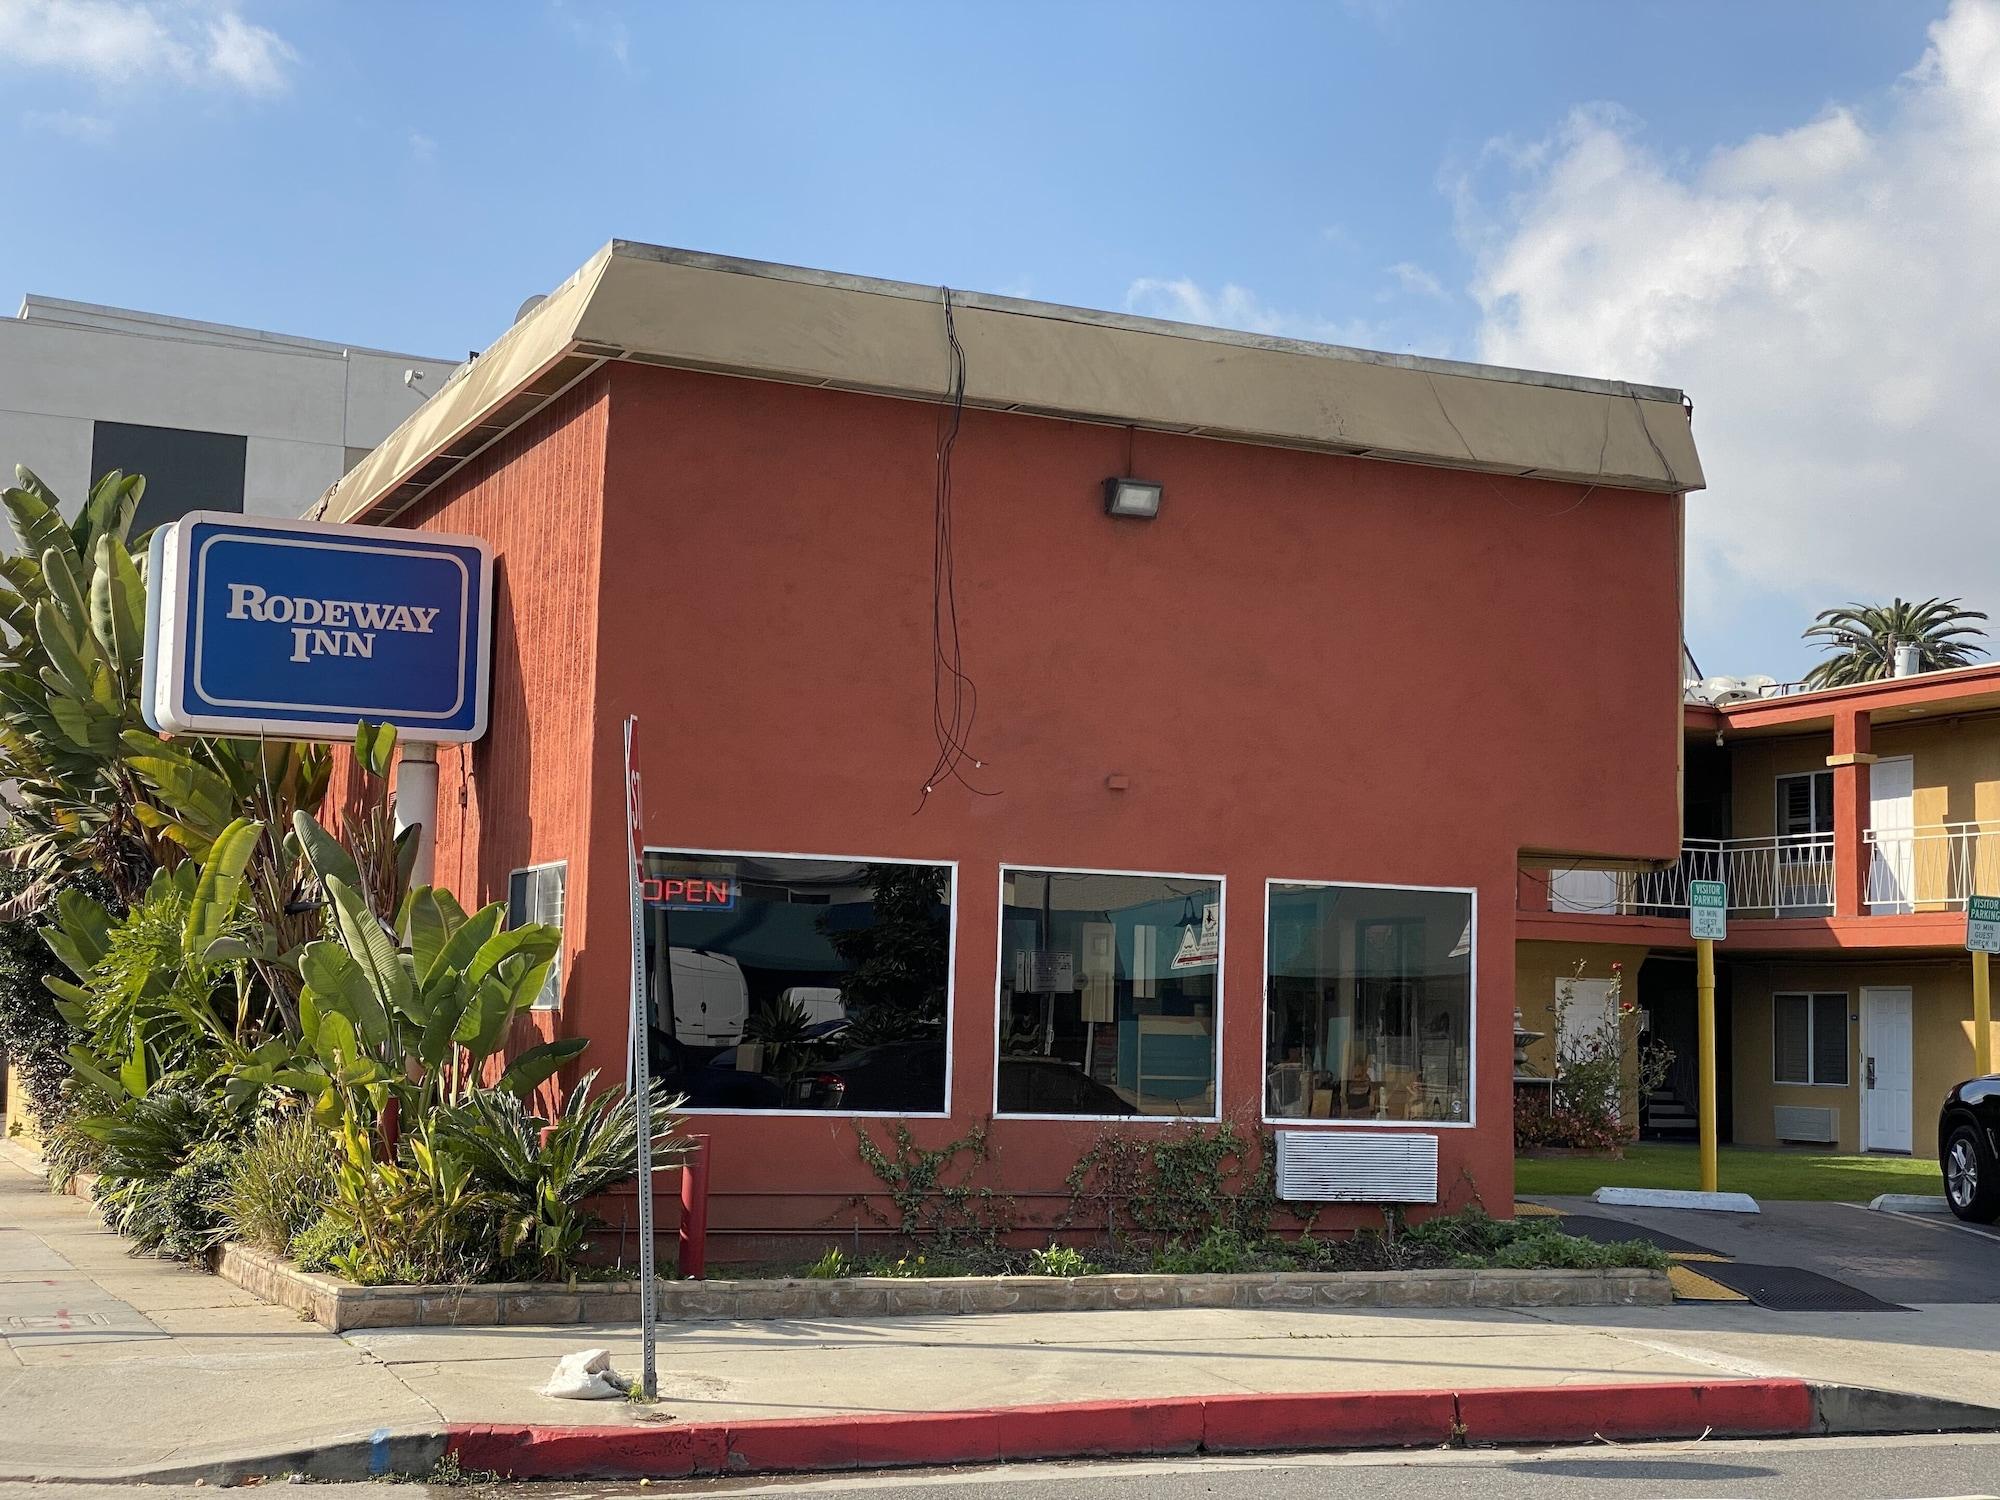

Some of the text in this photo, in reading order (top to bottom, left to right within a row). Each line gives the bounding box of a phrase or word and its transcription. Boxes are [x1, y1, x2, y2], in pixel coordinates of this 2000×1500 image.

[226, 583, 440, 633] RODEWAY
[289, 627, 376, 663] INN
[643, 879, 726, 903] OPEN
[1695, 884, 1721, 895] VISITOR
[1694, 895, 1723, 906] PARKING
[1973, 898, 1999, 910] VISITOR
[1970, 908, 2000, 921] PARKING
[1699, 918, 1717, 926] GUEST
[1974, 923, 1981, 931] 10
[1695, 926, 1722, 935] CHECK IN
[1974, 932, 1993, 940] GUEST
[1970, 939, 1998, 949] CHECK IN
